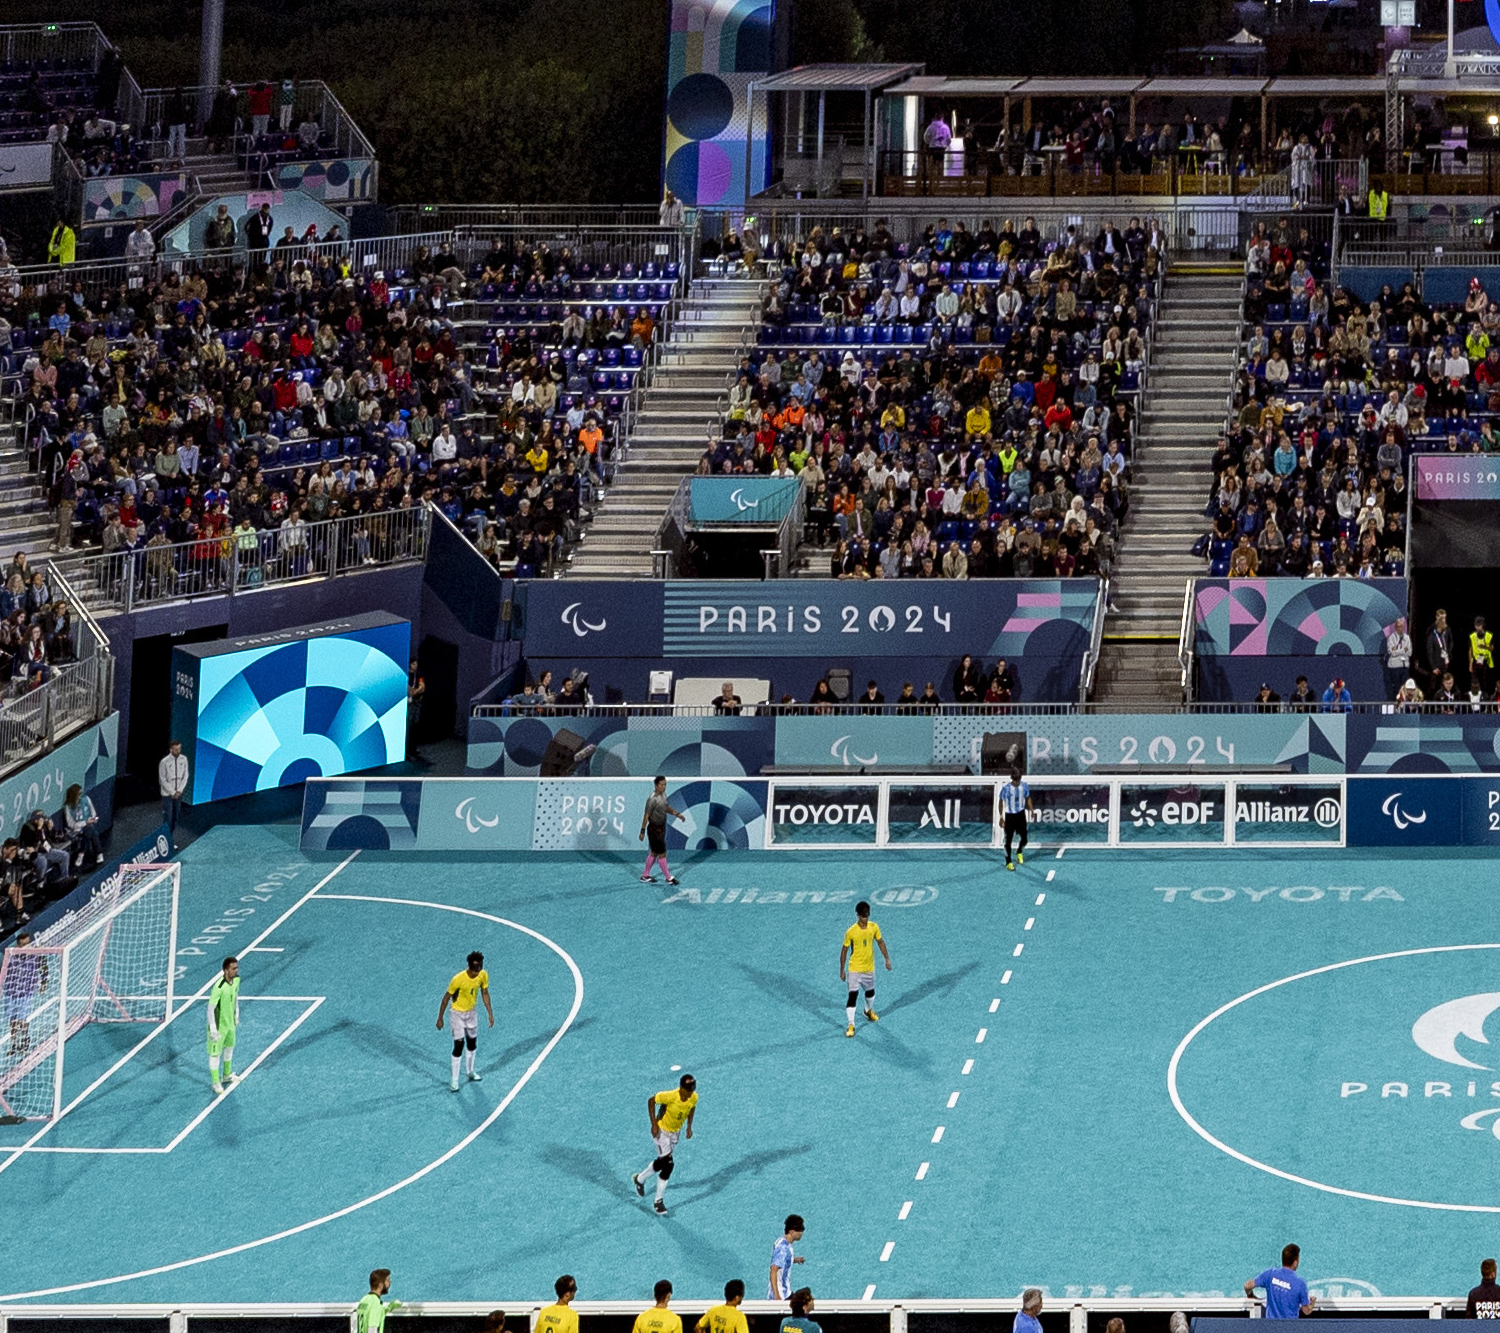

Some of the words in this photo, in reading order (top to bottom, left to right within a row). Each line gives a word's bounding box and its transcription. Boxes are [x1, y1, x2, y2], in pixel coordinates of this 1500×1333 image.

[841, 606, 950, 633] 2024
[971, 736, 1098, 765] PRiS
[1119, 736, 1234, 764] 2024
[13, 768, 64, 822] 2024
[775, 804, 874, 825] TOYOTA
[1025, 803, 1109, 824] nasonic
[1235, 802, 1309, 823] Allianz
[561, 817, 623, 835] 2024
[240, 863, 308, 903] 2024
[662, 888, 856, 904] Allianz
[1153, 886, 1405, 902] TOYOTA
